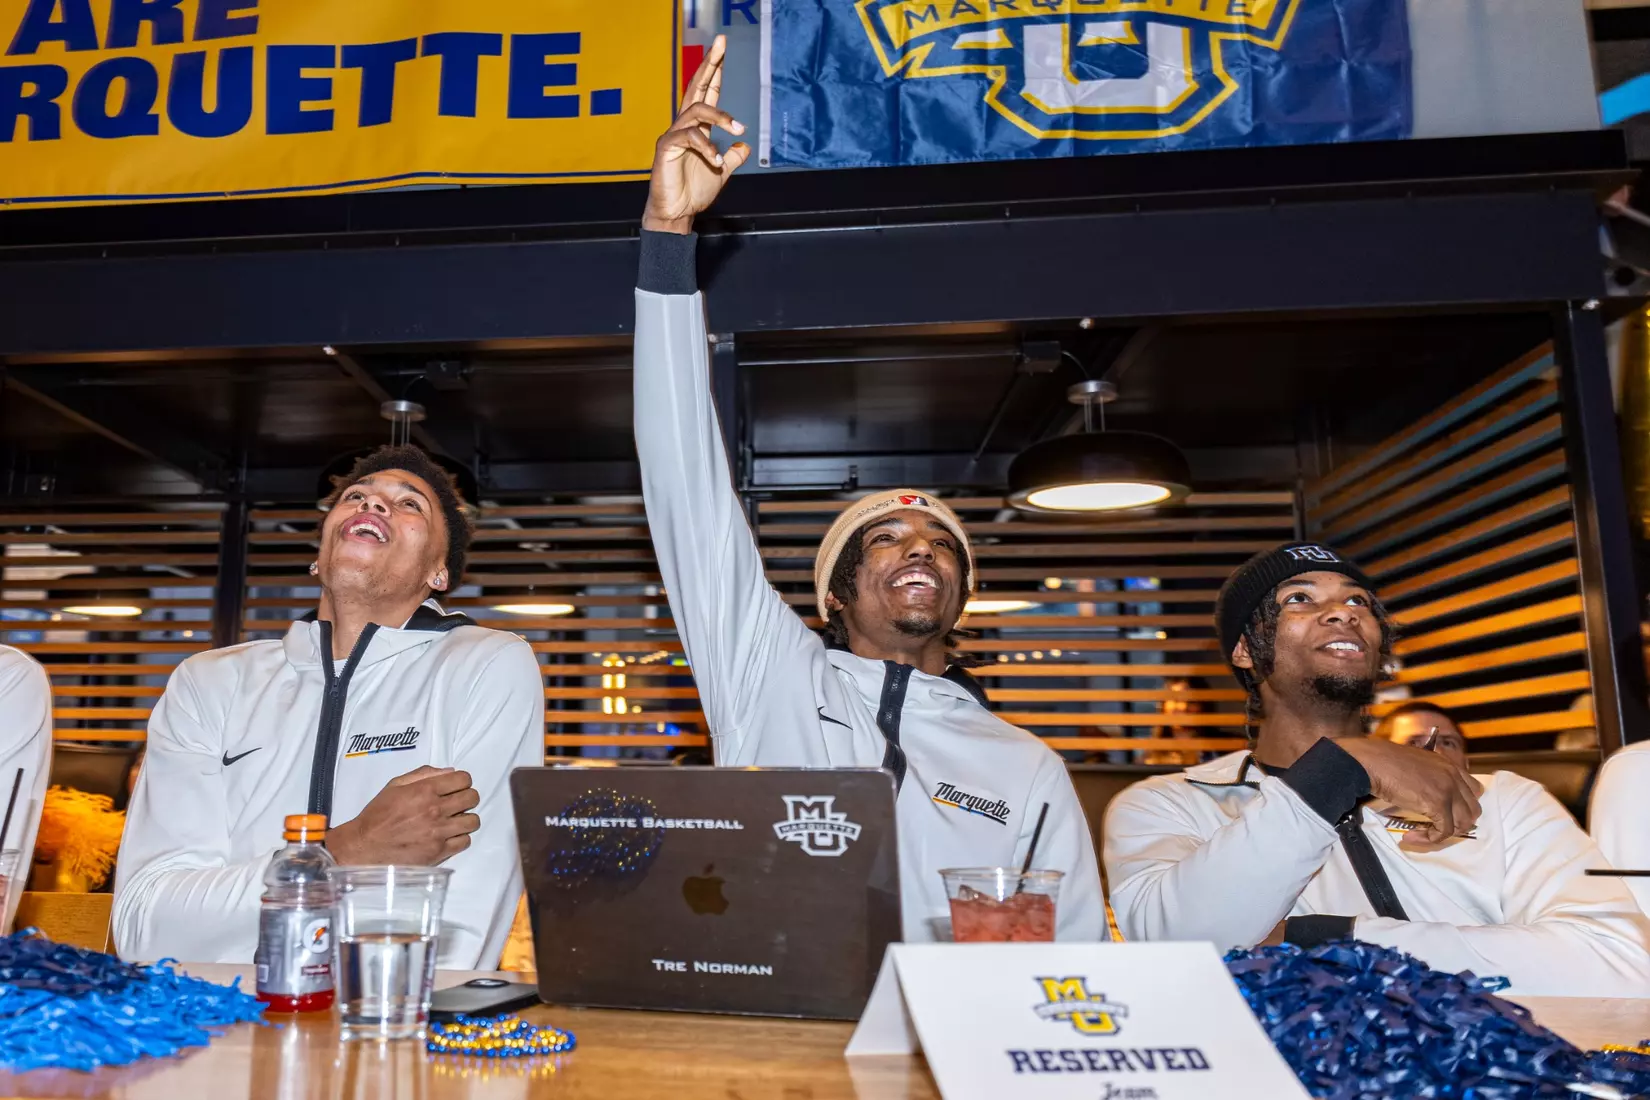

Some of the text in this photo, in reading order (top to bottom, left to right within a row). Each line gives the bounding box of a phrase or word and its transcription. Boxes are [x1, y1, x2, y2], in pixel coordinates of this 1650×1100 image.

[347, 726, 420, 753] Marquette
[933, 781, 1010, 820] Marquette
[1006, 1049, 1211, 1073] RESERVED
